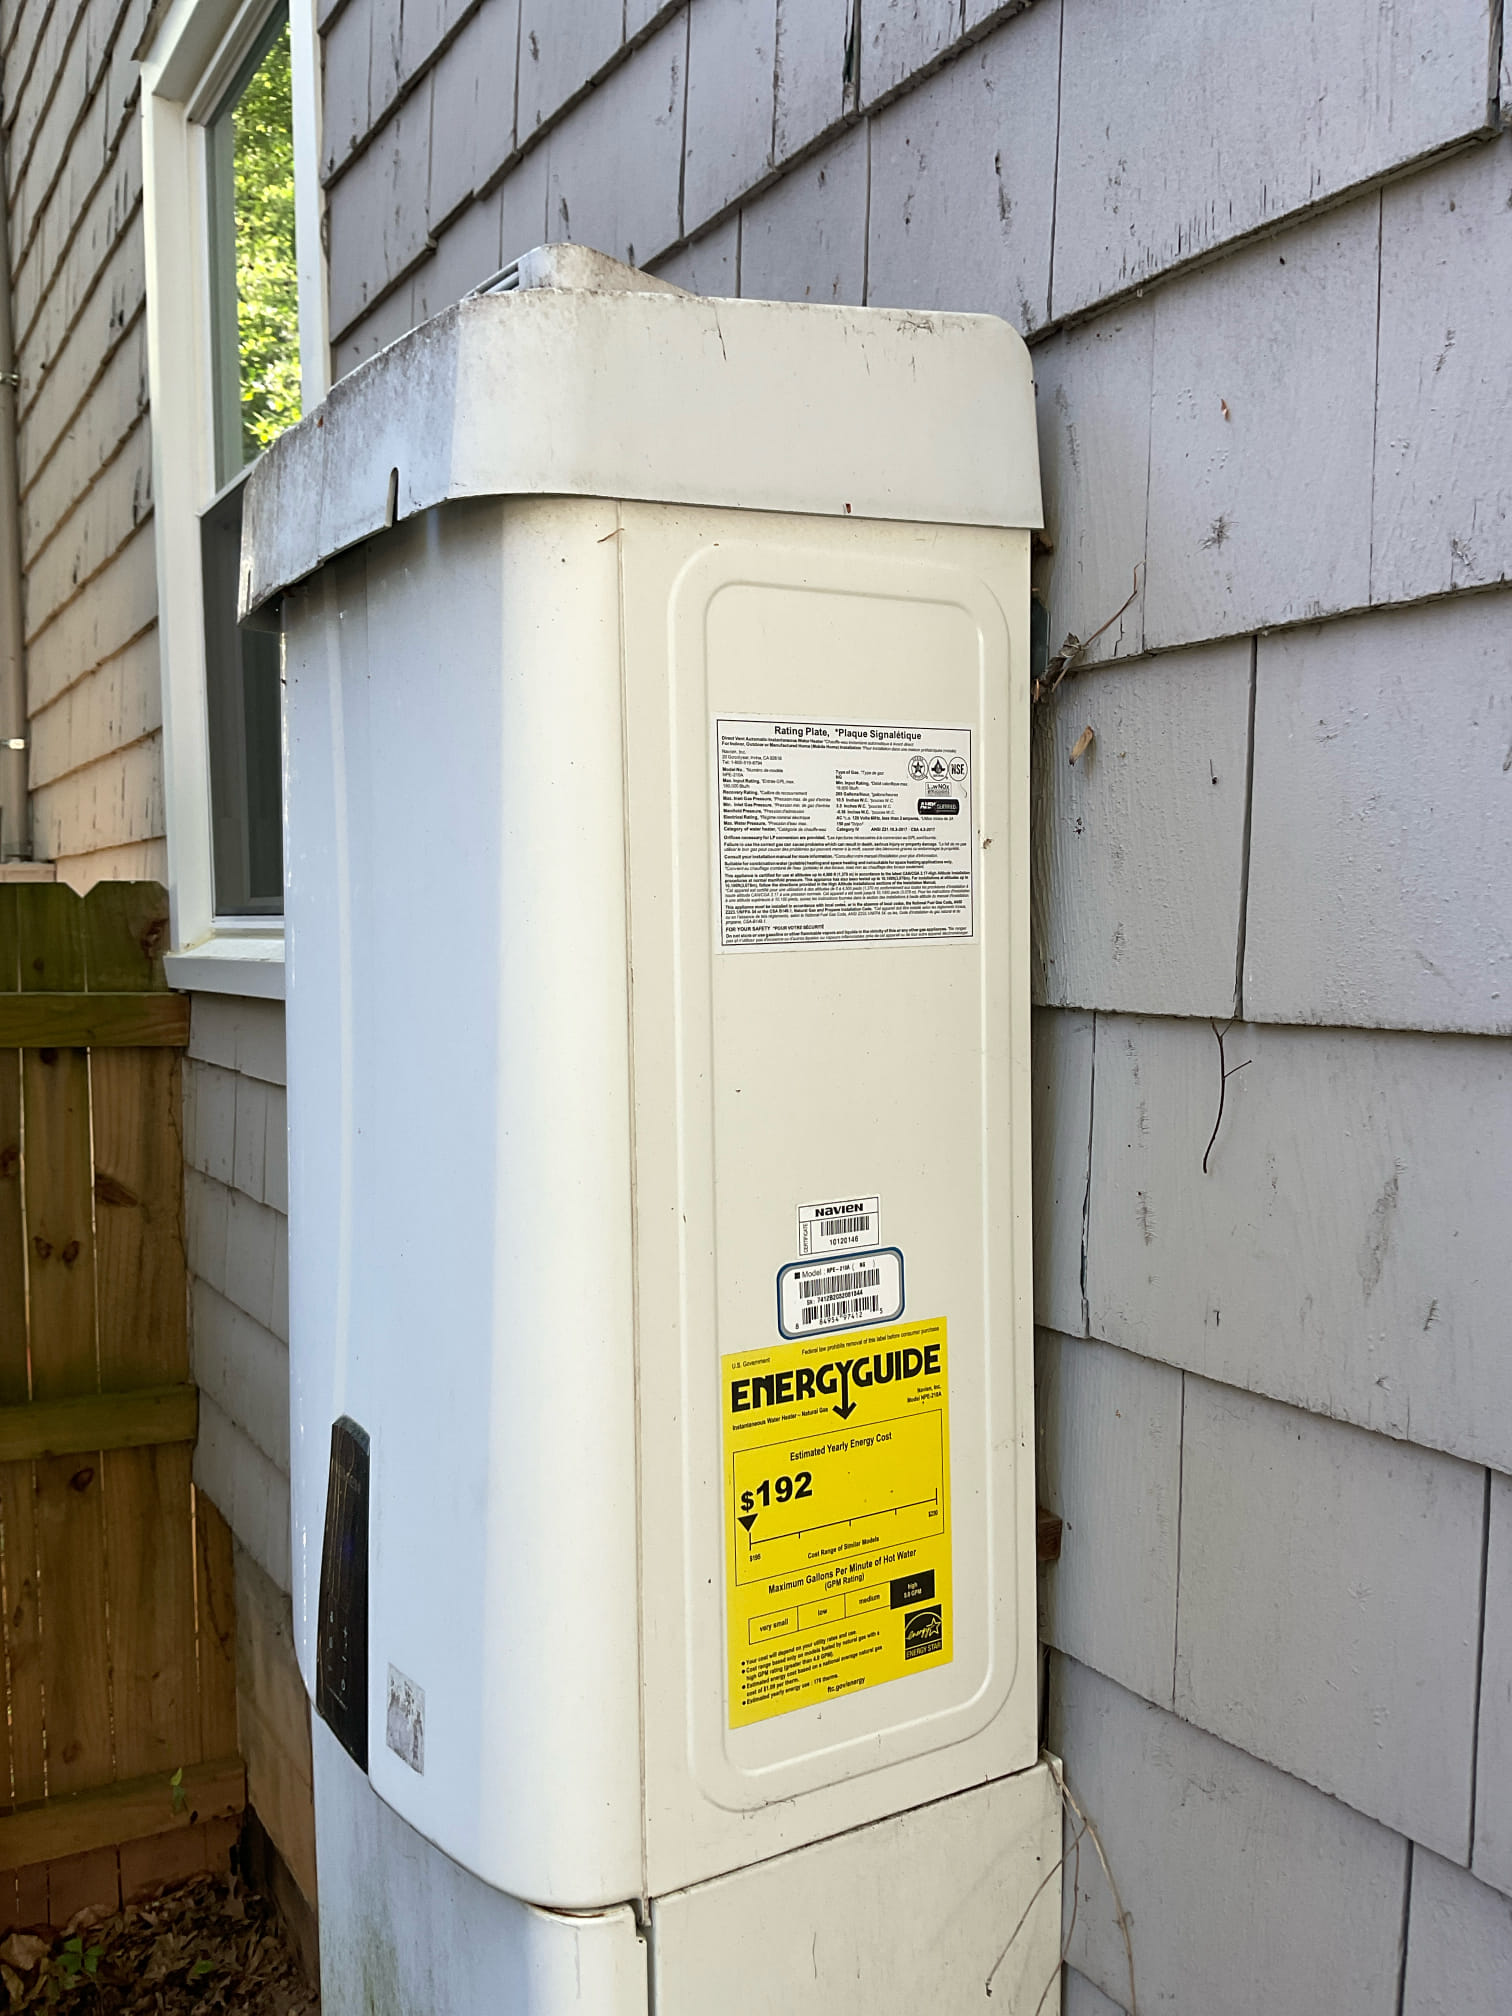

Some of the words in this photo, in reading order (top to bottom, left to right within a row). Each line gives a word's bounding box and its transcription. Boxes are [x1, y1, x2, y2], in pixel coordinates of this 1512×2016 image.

[775, 726, 803, 736] Rating
[806, 728, 830, 737] Plate,
[870, 730, 921, 741] Signalétique
[951, 764, 964, 775] NSF
[830, 1235, 858, 1245] 10120146
[802, 1269, 822, 1278] Model
[802, 1347, 818, 1355] Federal
[921, 1327, 939, 1335] purchase
[743, 1358, 770, 1367] Government
[907, 1395, 920, 1403] Model
[733, 1420, 765, 1431] Instantaneous
[790, 1446, 825, 1462] Estimated
[827, 1440, 848, 1454] Yearly
[850, 1435, 874, 1449] Energy
[876, 1432, 892, 1443] Cost
[740, 1471, 813, 1513] $192
[821, 1547, 836, 1556] Range
[844, 1541, 861, 1550] Similar
[862, 1536, 879, 1545] Models
[768, 1578, 804, 1594] Maximum
[806, 1569, 833, 1584] Gallons
[835, 1567, 847, 1575] Per
[849, 1559, 872, 1573] Minute
[874, 1558, 882, 1566] of
[883, 1554, 895, 1564] Hot
[897, 1549, 916, 1561] Water
[824, 1580, 841, 1591] (GPM
[843, 1574, 865, 1586] Rating)
[907, 1582, 918, 1590] high
[911, 1588, 922, 1597] GPM
[859, 1594, 880, 1604] medium
[818, 1608, 828, 1616] low
[760, 1622, 772, 1632] very
[773, 1618, 789, 1628] small
[778, 1647, 794, 1656] depend
[804, 1648, 821, 1656] models
[906, 1645, 927, 1658] ENERGY
[928, 1642, 941, 1652] STAR
[747, 1678, 770, 1689] Estimated
[771, 1674, 786, 1682] energy
[823, 1658, 840, 1666] national
[841, 1653, 858, 1661] average
[859, 1647, 874, 1655] natural
[784, 1662, 802, 1671] (greater
[747, 1694, 770, 1705] Estimated
[771, 1690, 784, 1699] yearly
[785, 1685, 800, 1693] energy
